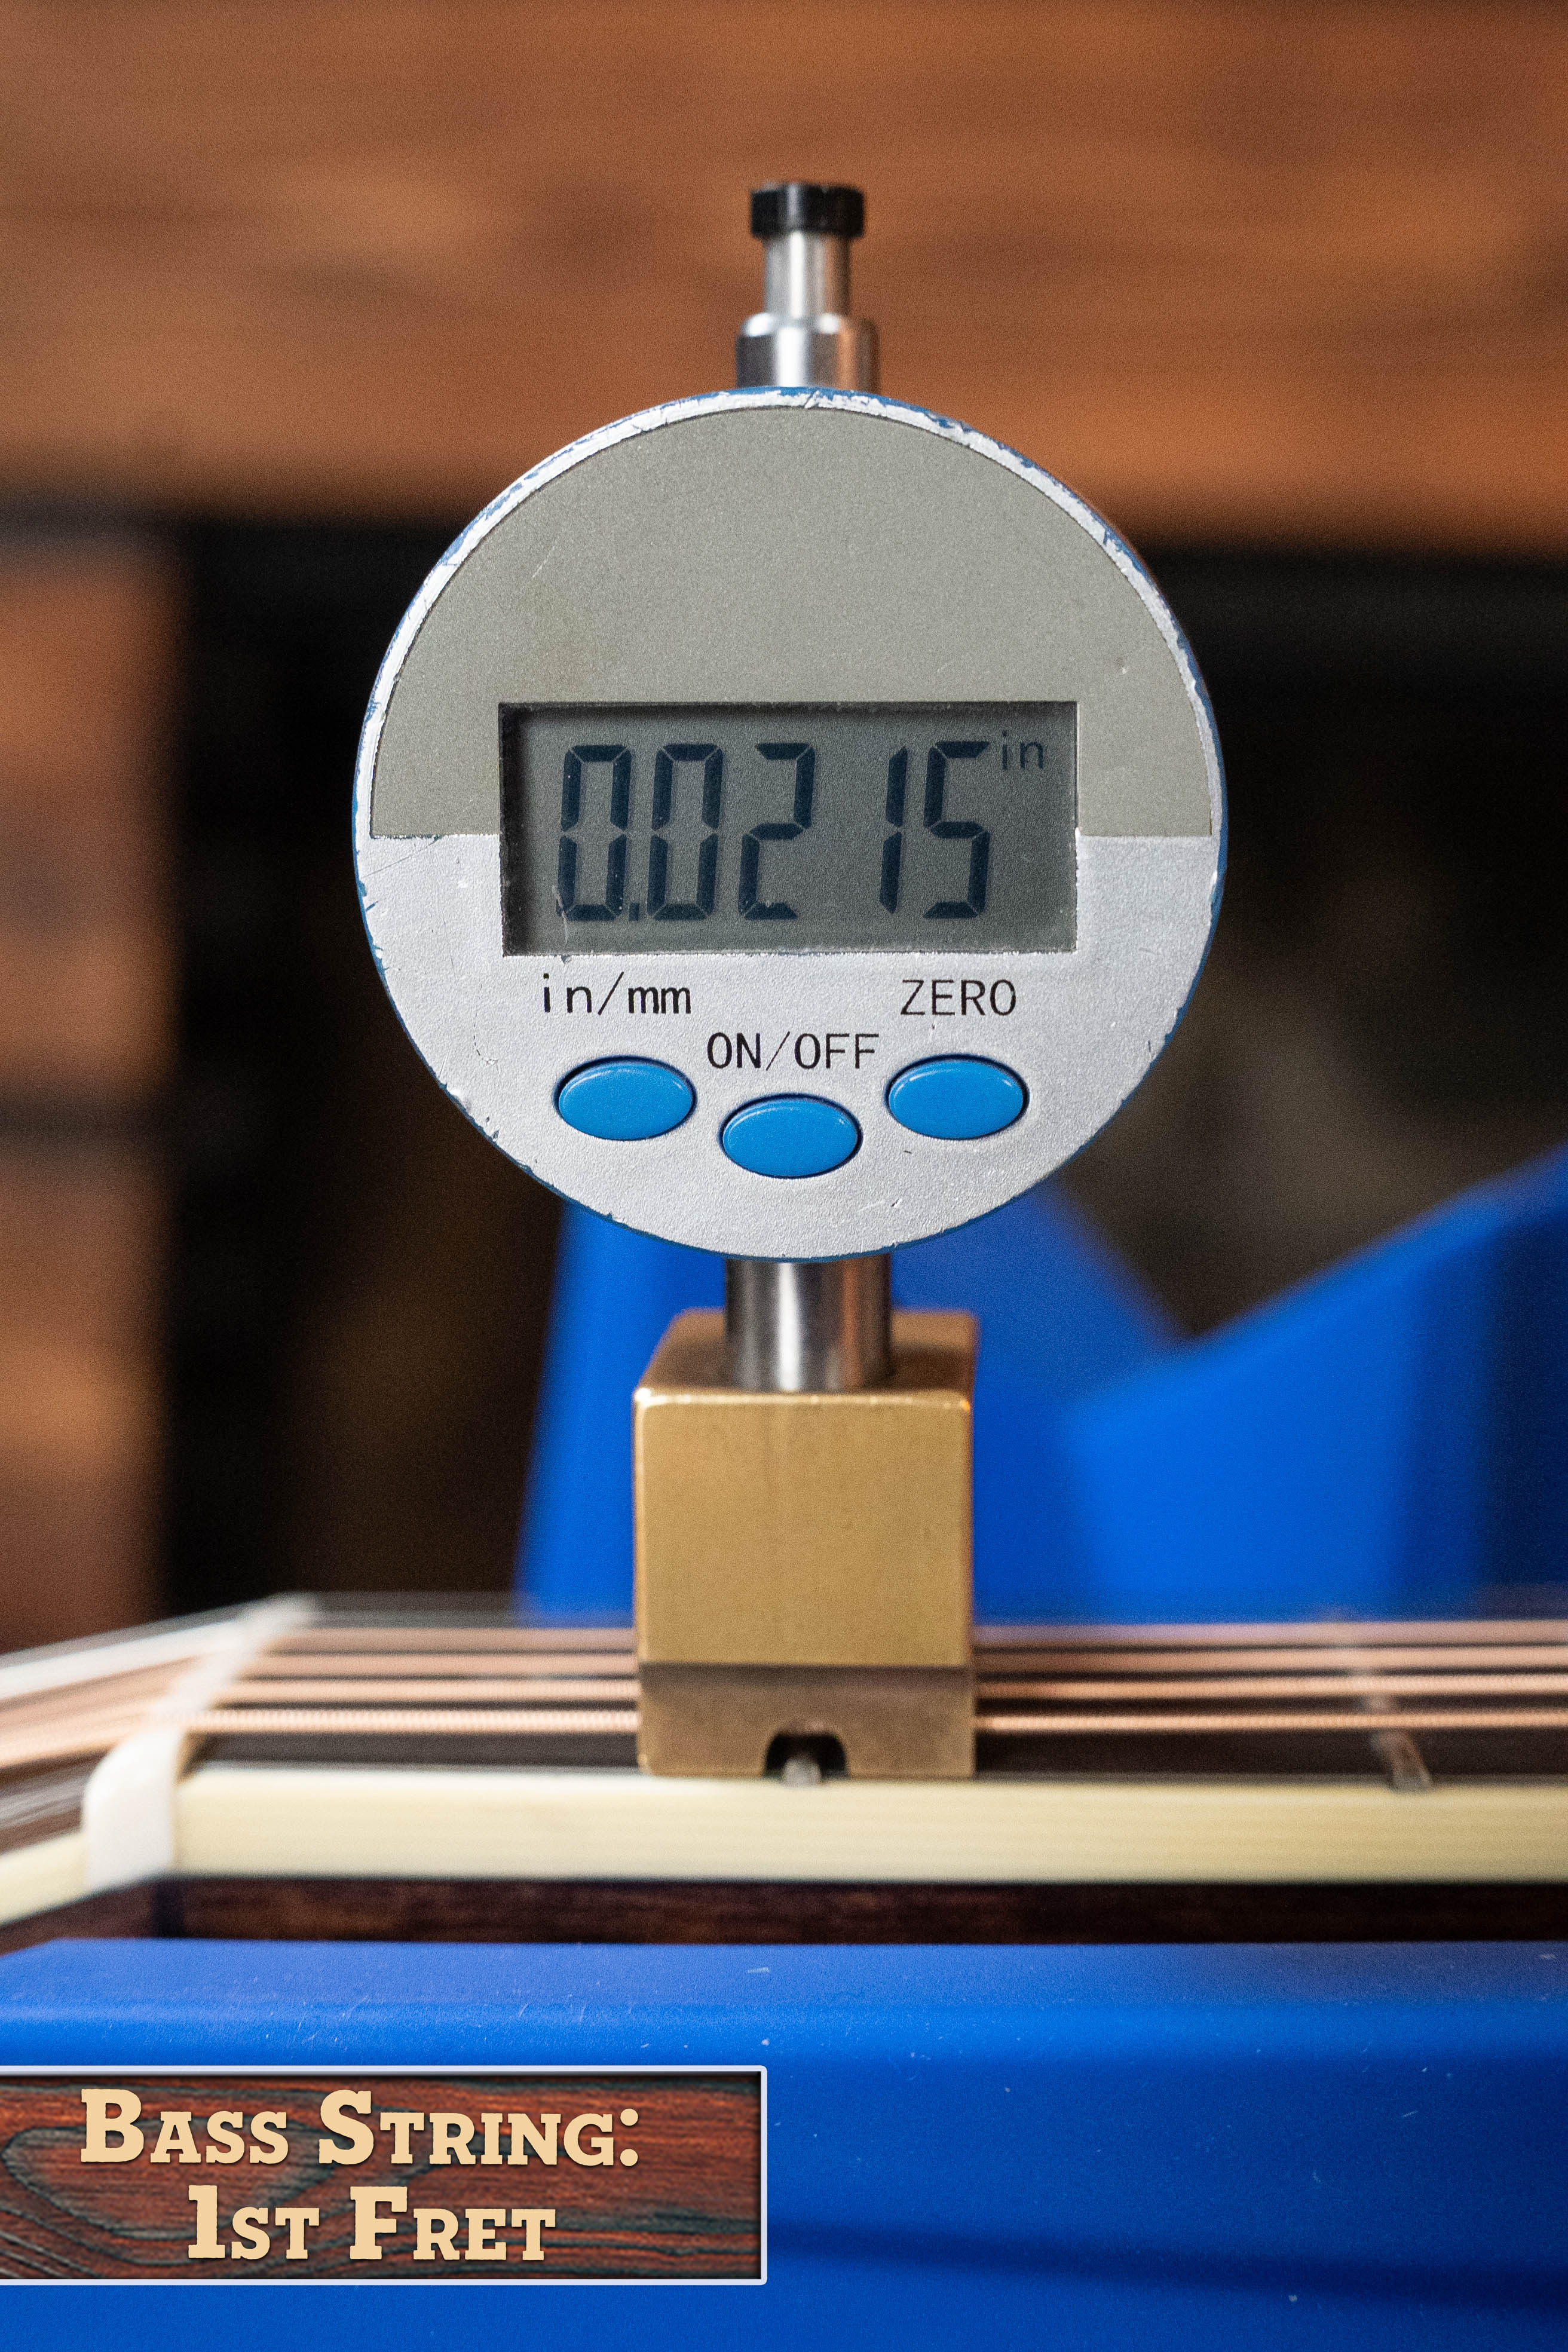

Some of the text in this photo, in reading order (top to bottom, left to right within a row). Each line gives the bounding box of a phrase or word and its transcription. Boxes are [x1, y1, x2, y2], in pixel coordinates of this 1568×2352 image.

[556, 730, 1045, 921] 0.0215 in
[543, 971, 692, 1016] in/mm
[901, 979, 1017, 1016] ZERO
[706, 1031, 880, 1071] ON/OFF
